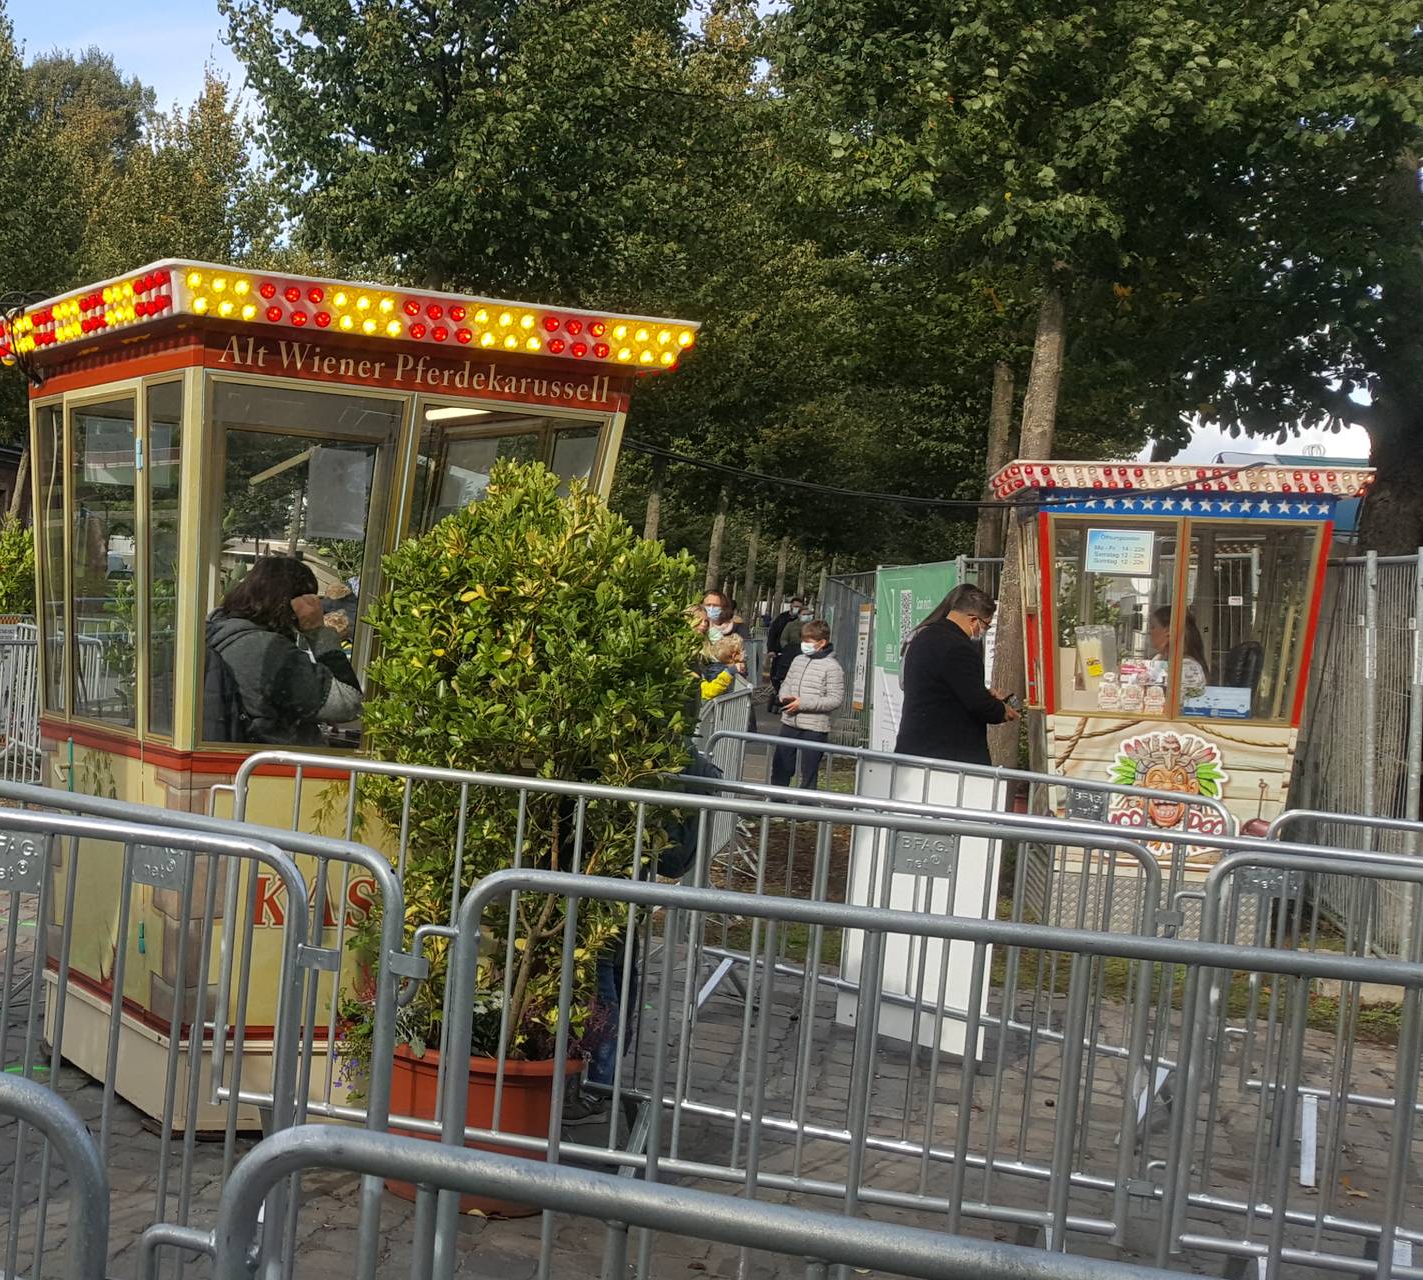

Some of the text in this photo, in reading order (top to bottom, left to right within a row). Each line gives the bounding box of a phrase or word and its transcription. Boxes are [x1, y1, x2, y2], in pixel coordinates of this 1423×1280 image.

[218, 335, 611, 404] Alt Wiener Pferdekarussell
